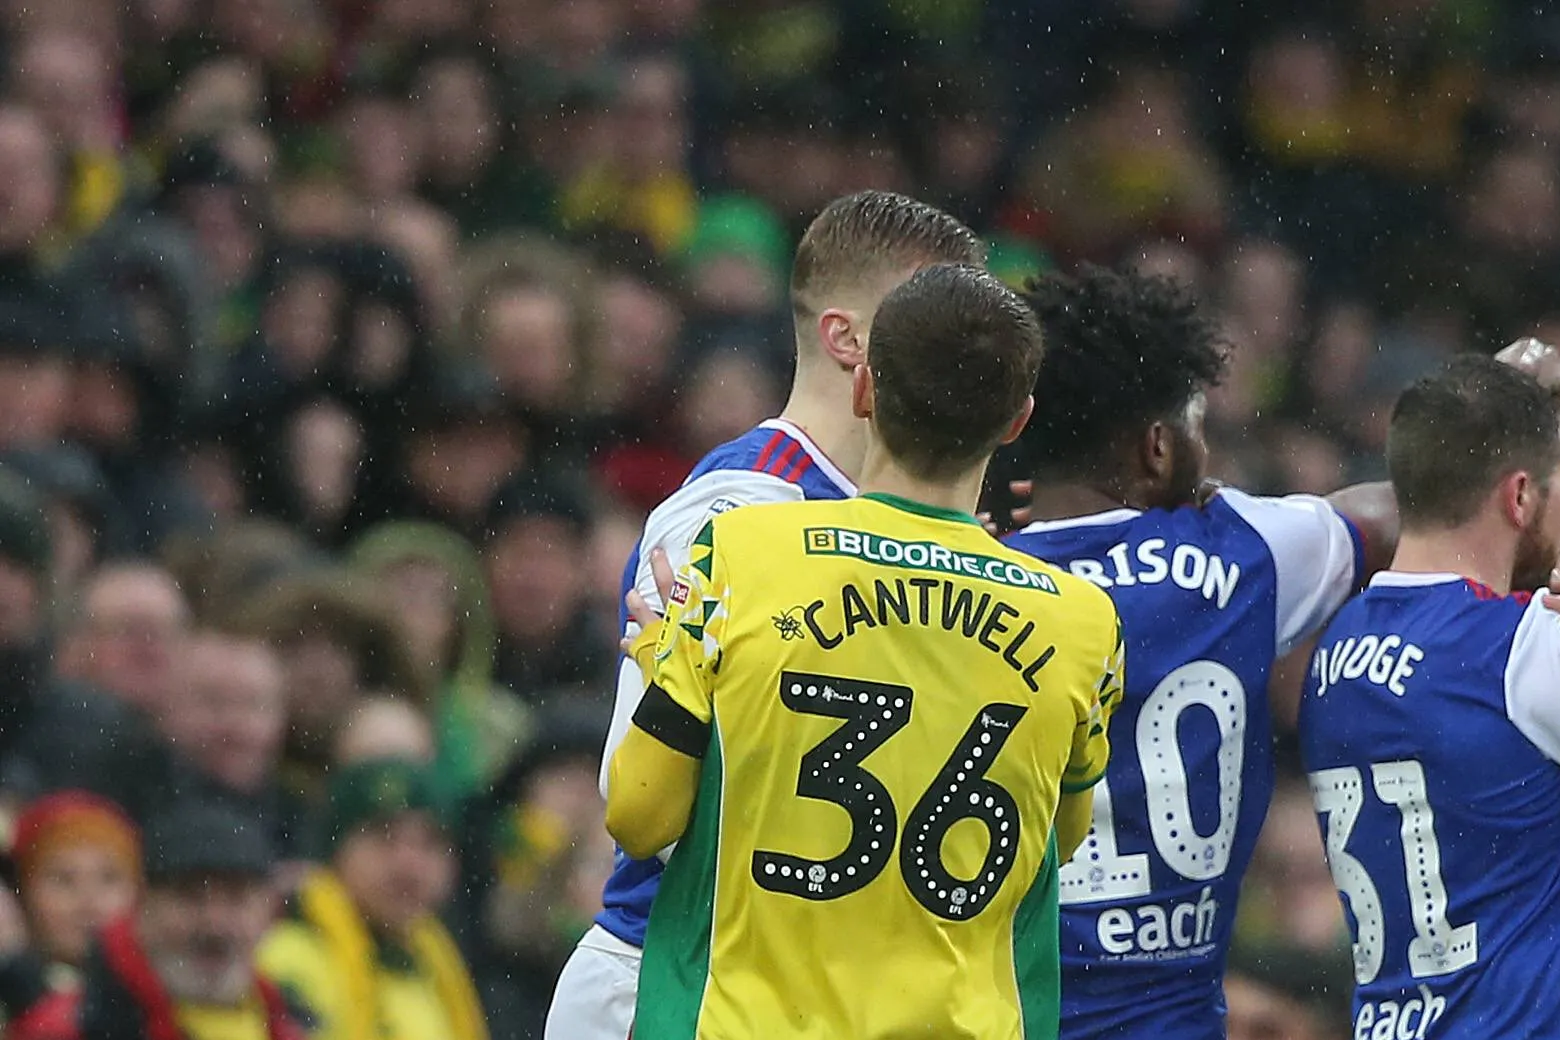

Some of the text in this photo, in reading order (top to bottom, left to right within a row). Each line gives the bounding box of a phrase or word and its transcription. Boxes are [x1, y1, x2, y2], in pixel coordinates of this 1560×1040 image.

[838, 530, 1057, 593] BLOORIE.COM
[1052, 538, 1240, 609] RISON
[804, 578, 1056, 693] CANTWELL
[1312, 634, 1424, 697] JUDGE
[751, 671, 1028, 922] 36
[1308, 760, 1478, 984] 31
[1097, 886, 1216, 954] each
